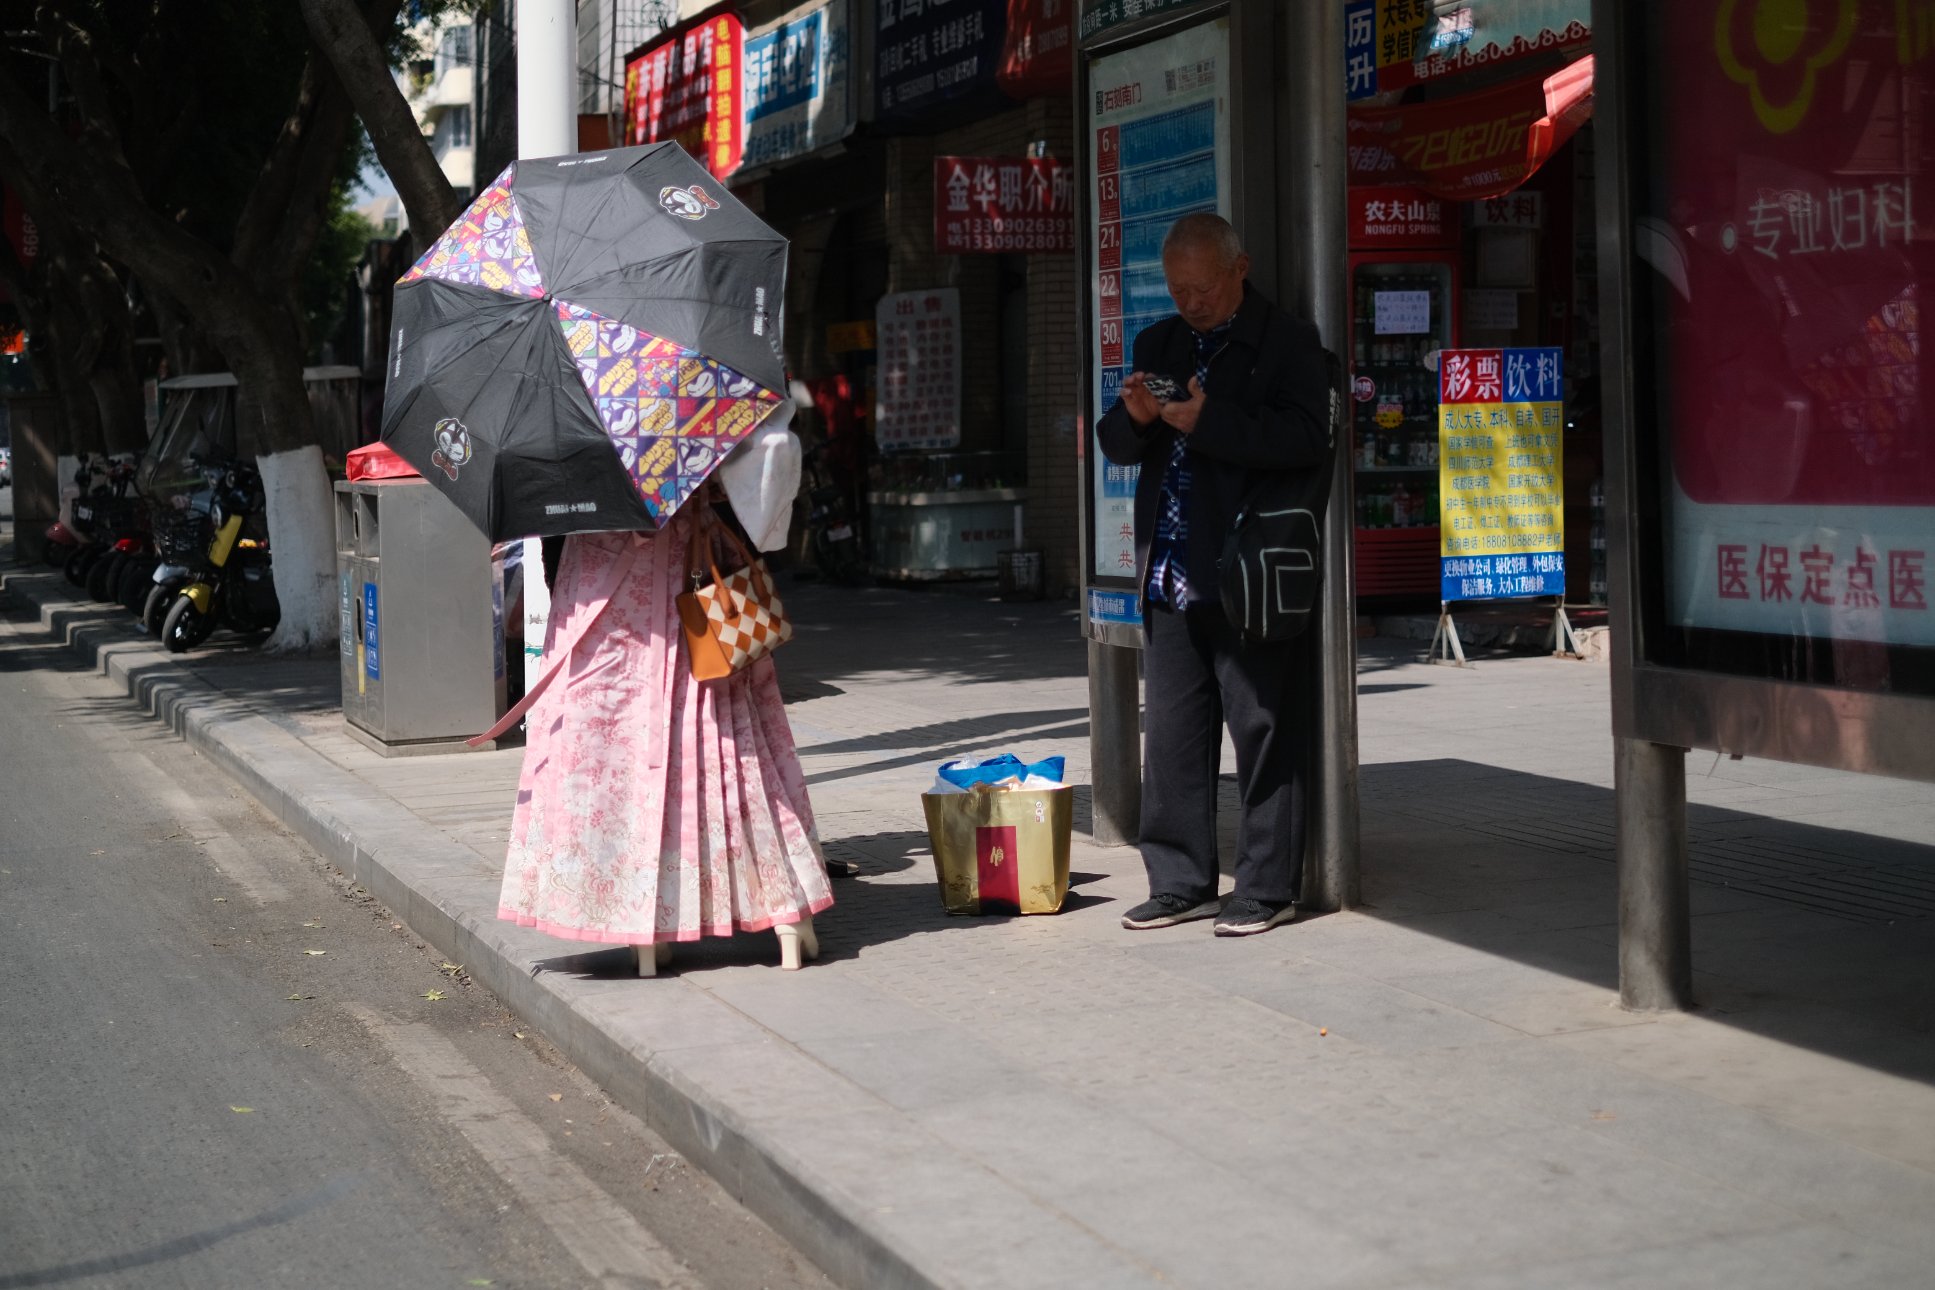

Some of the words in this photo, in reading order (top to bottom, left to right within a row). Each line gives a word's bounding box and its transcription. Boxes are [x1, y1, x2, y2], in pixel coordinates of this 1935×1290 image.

[1347, 7, 1373, 48] 历
[1104, 81, 1142, 111] 石刻南门
[946, 163, 1075, 213] 金华职介所
[1100, 177, 1115, 201] 13
[1364, 199, 1441, 223] 农夫山泉
[1485, 196, 1536, 224] 饮料
[1746, 182, 1917, 261] 专业妇科
[962, 218, 1075, 233] 13309026391
[1100, 225, 1115, 249] 21
[1364, 224, 1406, 235] NONGFU
[1408, 224, 1441, 235] SPRING
[962, 234, 1076, 250] 13309028013
[1101, 274, 1116, 297] 22
[1102, 322, 1117, 345] 30
[1103, 371, 1119, 388] 701
[1444, 353, 1500, 400] 彩票
[1505, 351, 1562, 398] 饮料
[1448, 456, 1494, 470] 四川师范大学
[1508, 454, 1554, 468] 成都理工大学
[1452, 476, 1490, 490] 成都医学院
[1508, 473, 1554, 488] 国家开放大学
[1119, 522, 1133, 542] 共
[1118, 549, 1133, 568] 共
[1717, 543, 1928, 610] 医保定点医
